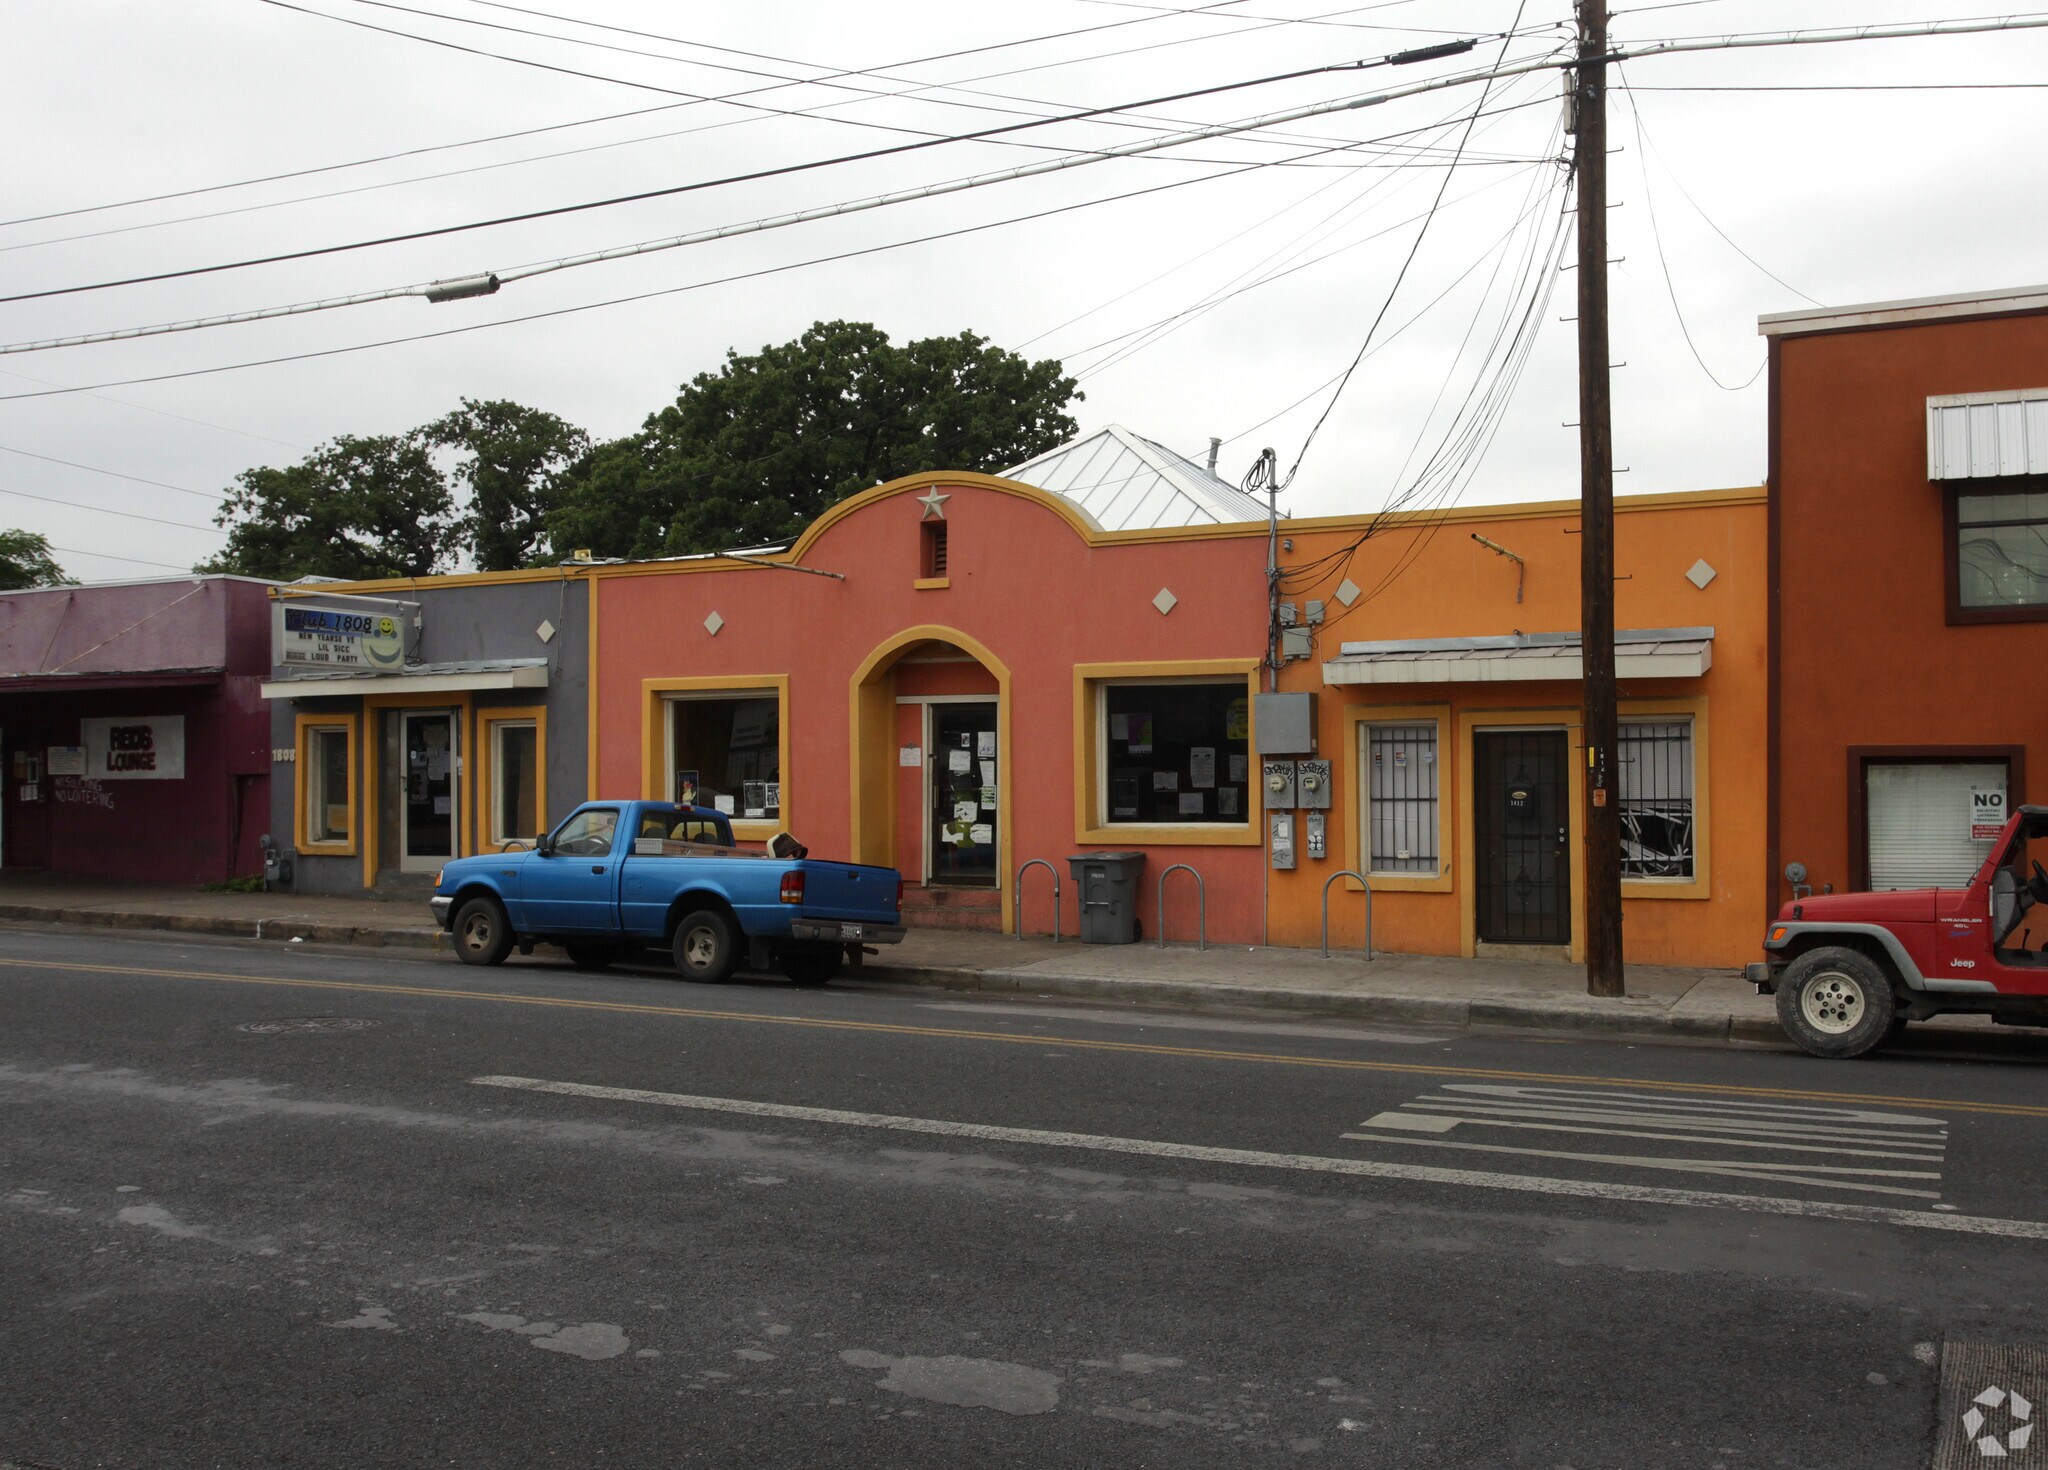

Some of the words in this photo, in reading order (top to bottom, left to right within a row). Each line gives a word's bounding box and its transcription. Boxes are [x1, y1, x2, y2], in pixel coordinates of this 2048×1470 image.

[335, 614, 373, 631] 1808
[299, 632, 313, 640] NEW
[318, 643, 330, 652] LIL
[334, 645, 350, 653] SICC
[311, 653, 330, 661] LOUD
[337, 655, 359, 663] PARTY
[107, 751, 157, 771] LOUNGE
[271, 749, 296, 761] 1808
[55, 790, 66, 802] NO
[1974, 793, 2003, 806] NO
[1950, 958, 1975, 969] Jeep
